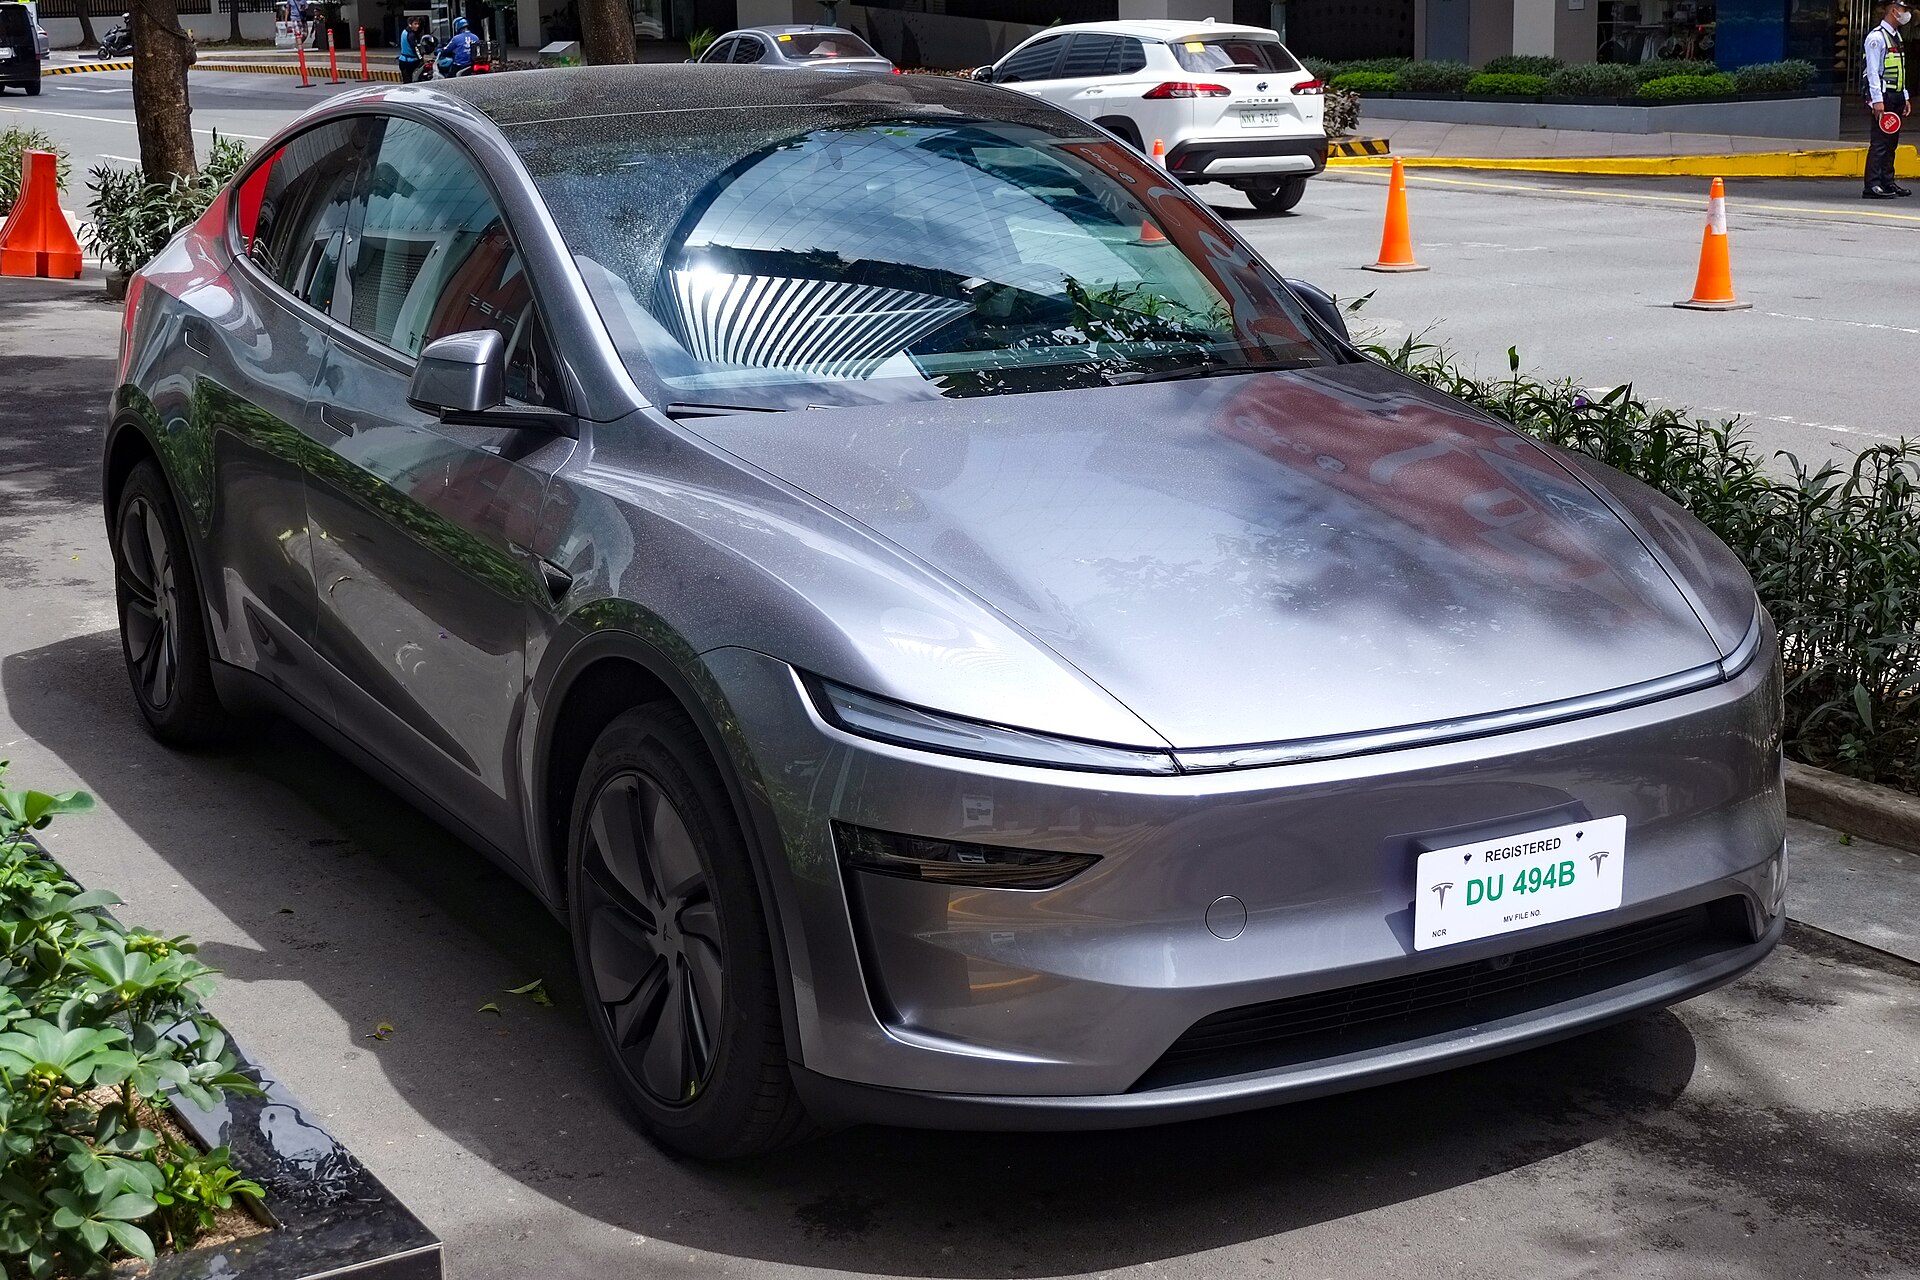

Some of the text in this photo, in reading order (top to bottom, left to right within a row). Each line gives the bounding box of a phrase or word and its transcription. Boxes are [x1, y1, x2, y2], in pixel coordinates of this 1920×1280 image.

[1884, 116, 1897, 130] STOP
[1485, 837, 1561, 863] REGISTERED
[1466, 860, 1575, 906] DU 494B
[1503, 909, 1542, 923] MV FILE NO.
[1431, 928, 1447, 938] NCR
